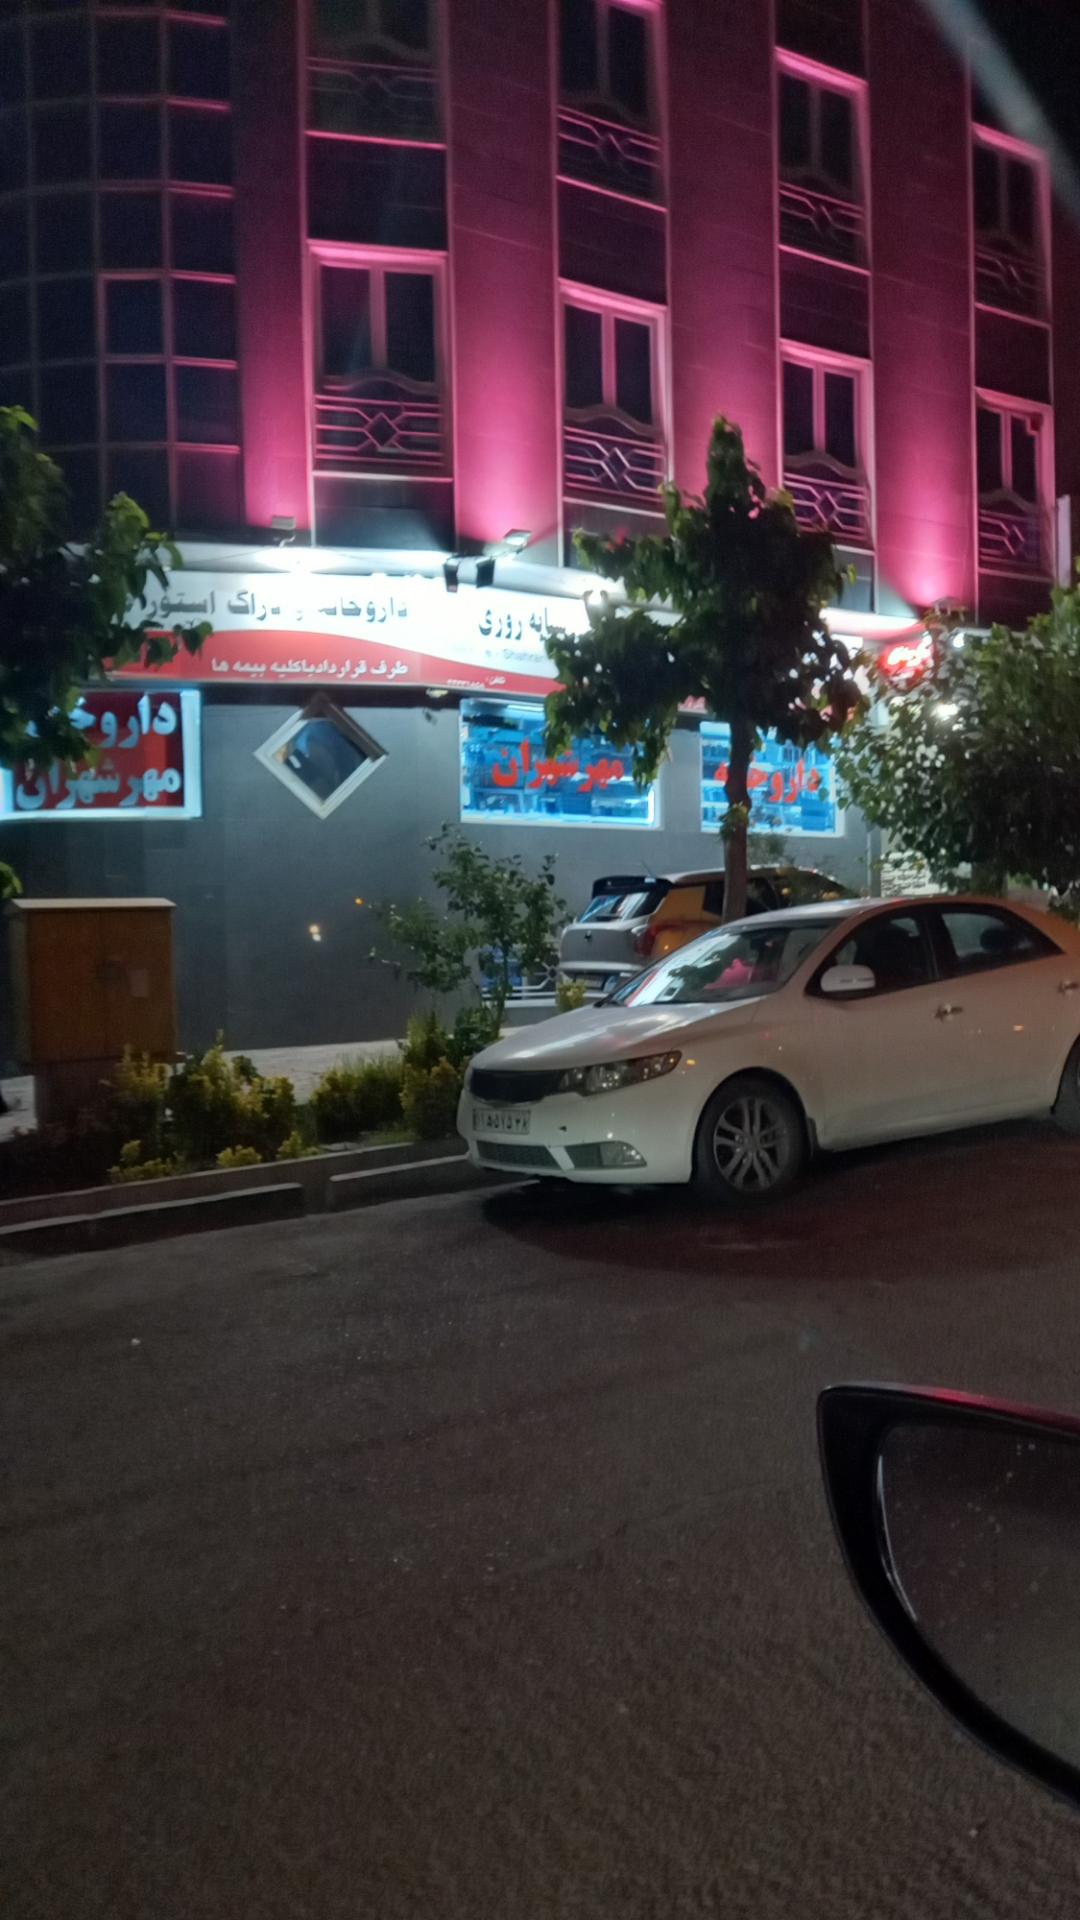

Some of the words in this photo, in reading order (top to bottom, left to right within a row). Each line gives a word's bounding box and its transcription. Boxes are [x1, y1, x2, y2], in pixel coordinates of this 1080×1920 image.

[210, 657, 230, 673] ها
[232, 659, 267, 678] بیمه
[370, 660, 409, 679] طرف
